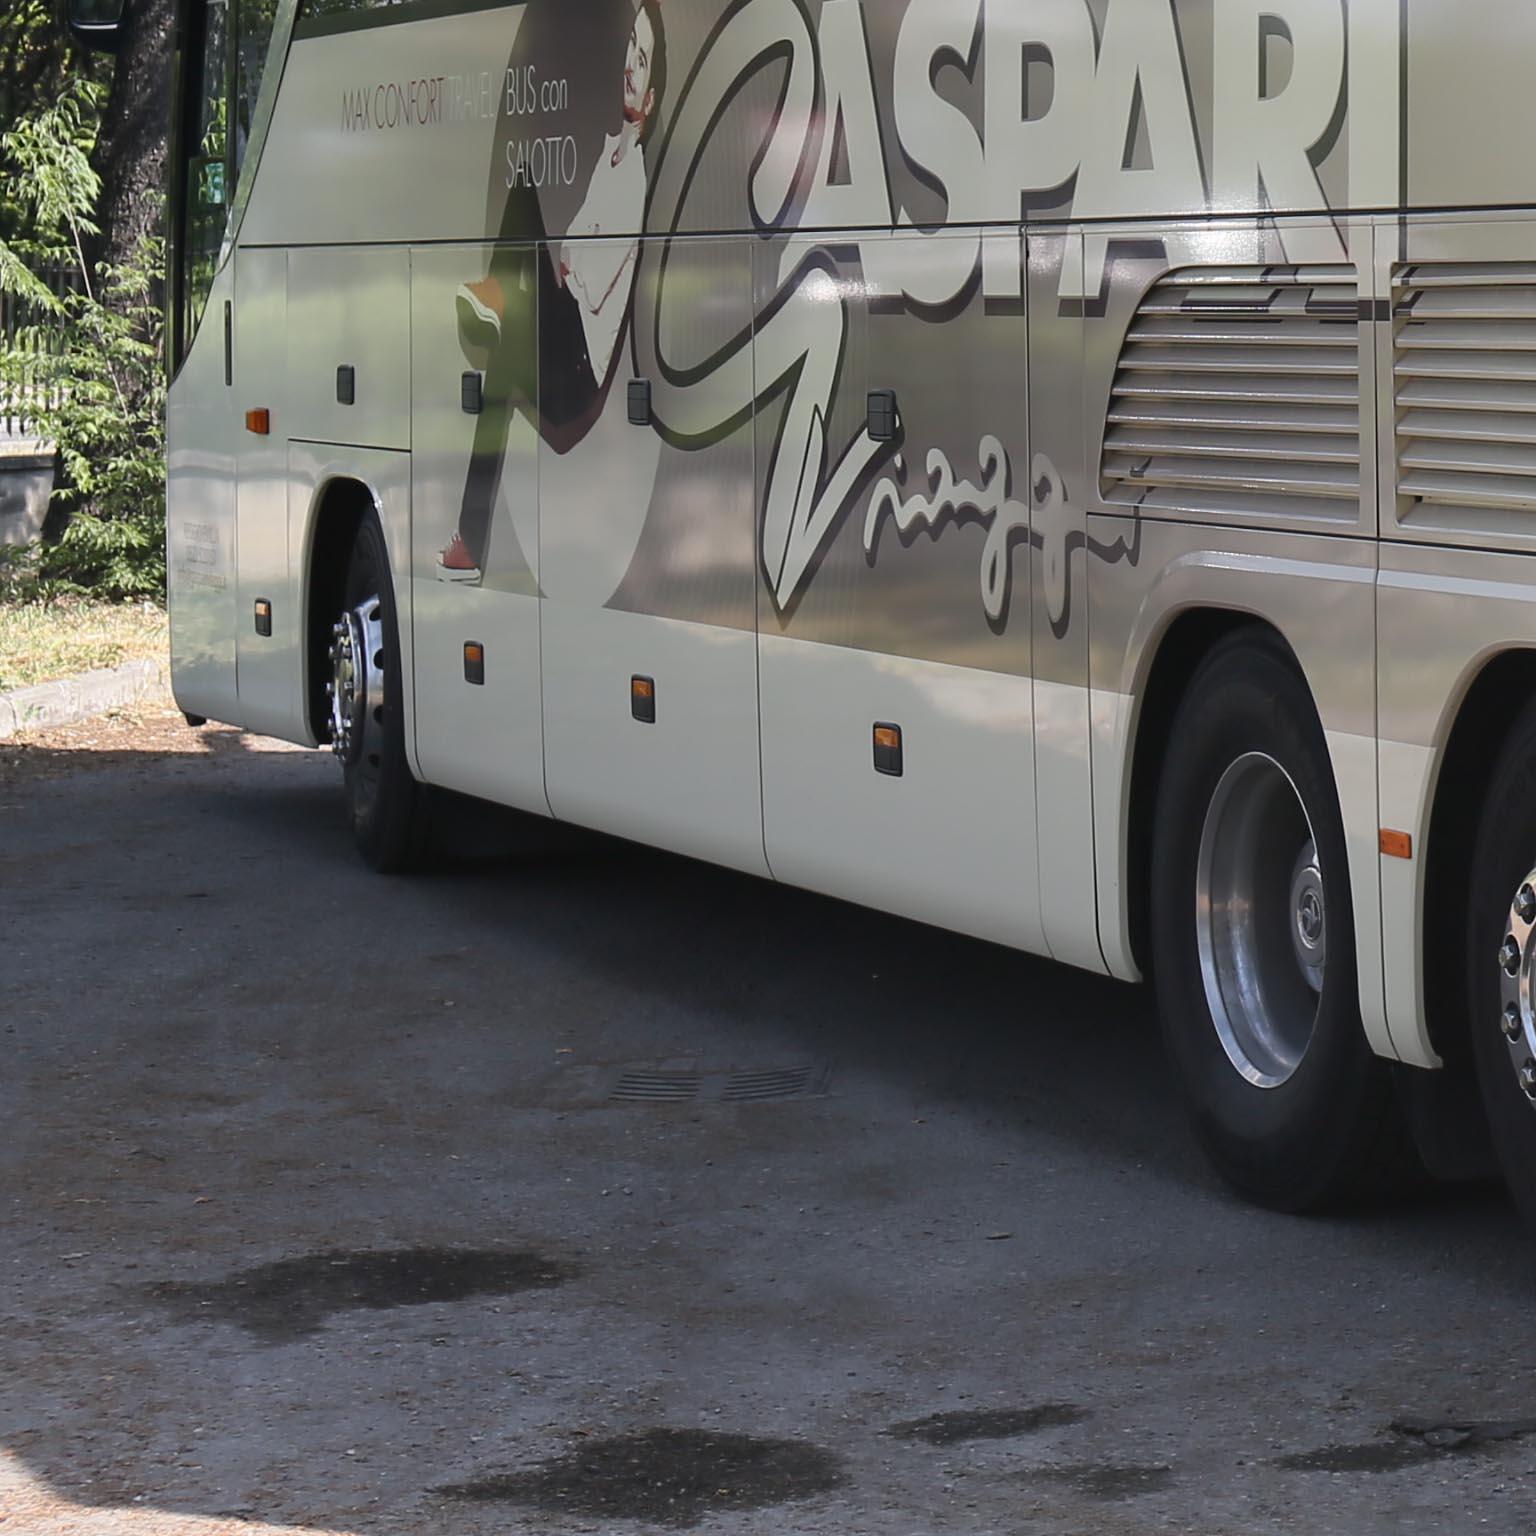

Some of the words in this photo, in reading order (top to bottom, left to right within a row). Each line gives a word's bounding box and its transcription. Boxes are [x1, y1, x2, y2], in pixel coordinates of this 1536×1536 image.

[340, 87, 372, 133] MAX
[373, 76, 445, 130] CONFORT
[506, 64, 537, 116] BUS
[540, 78, 568, 112] con
[505, 135, 578, 189] SALOTTO
